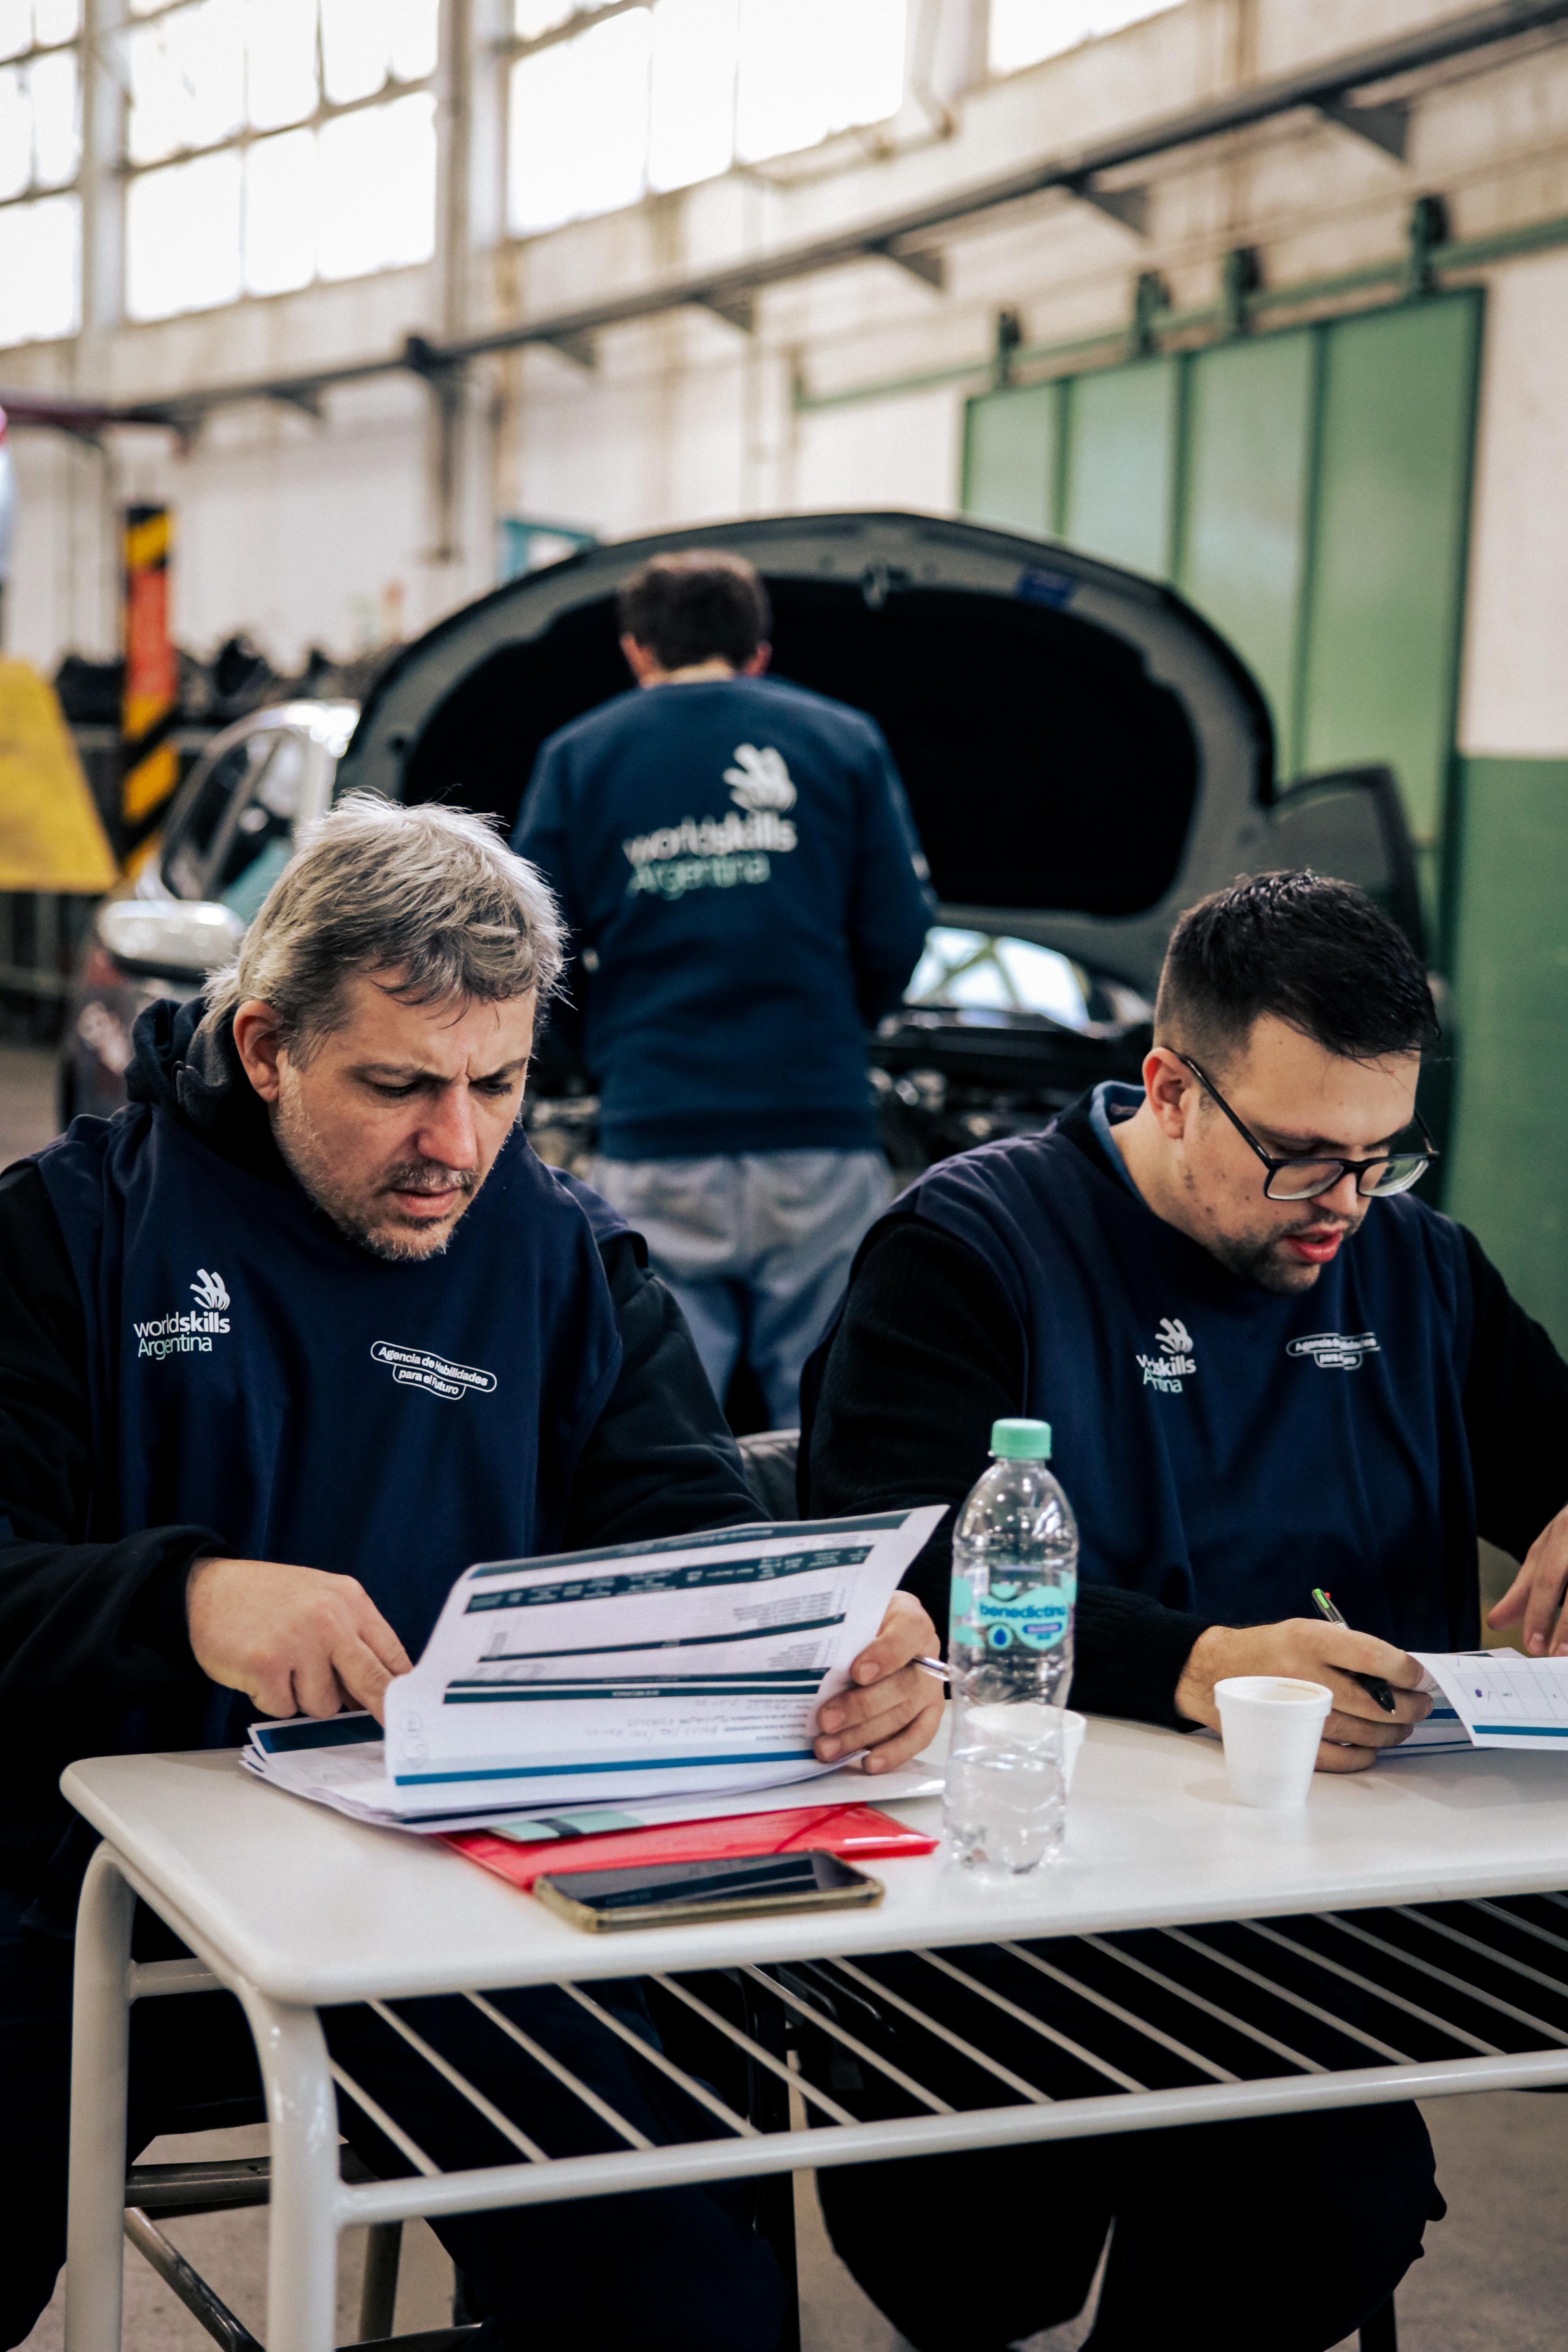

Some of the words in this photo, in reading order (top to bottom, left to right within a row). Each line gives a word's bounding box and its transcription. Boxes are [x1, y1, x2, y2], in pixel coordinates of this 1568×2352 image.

[133, 1311, 230, 1338] worldskills
[138, 1332, 212, 1360] Argentina
[378, 1346, 420, 1360] Agencia
[422, 1357, 435, 1368] de
[435, 1361, 488, 1386] Habilidades
[399, 1369, 422, 1381] para
[423, 1375, 432, 1384] el
[431, 1378, 459, 1395] Futuro
